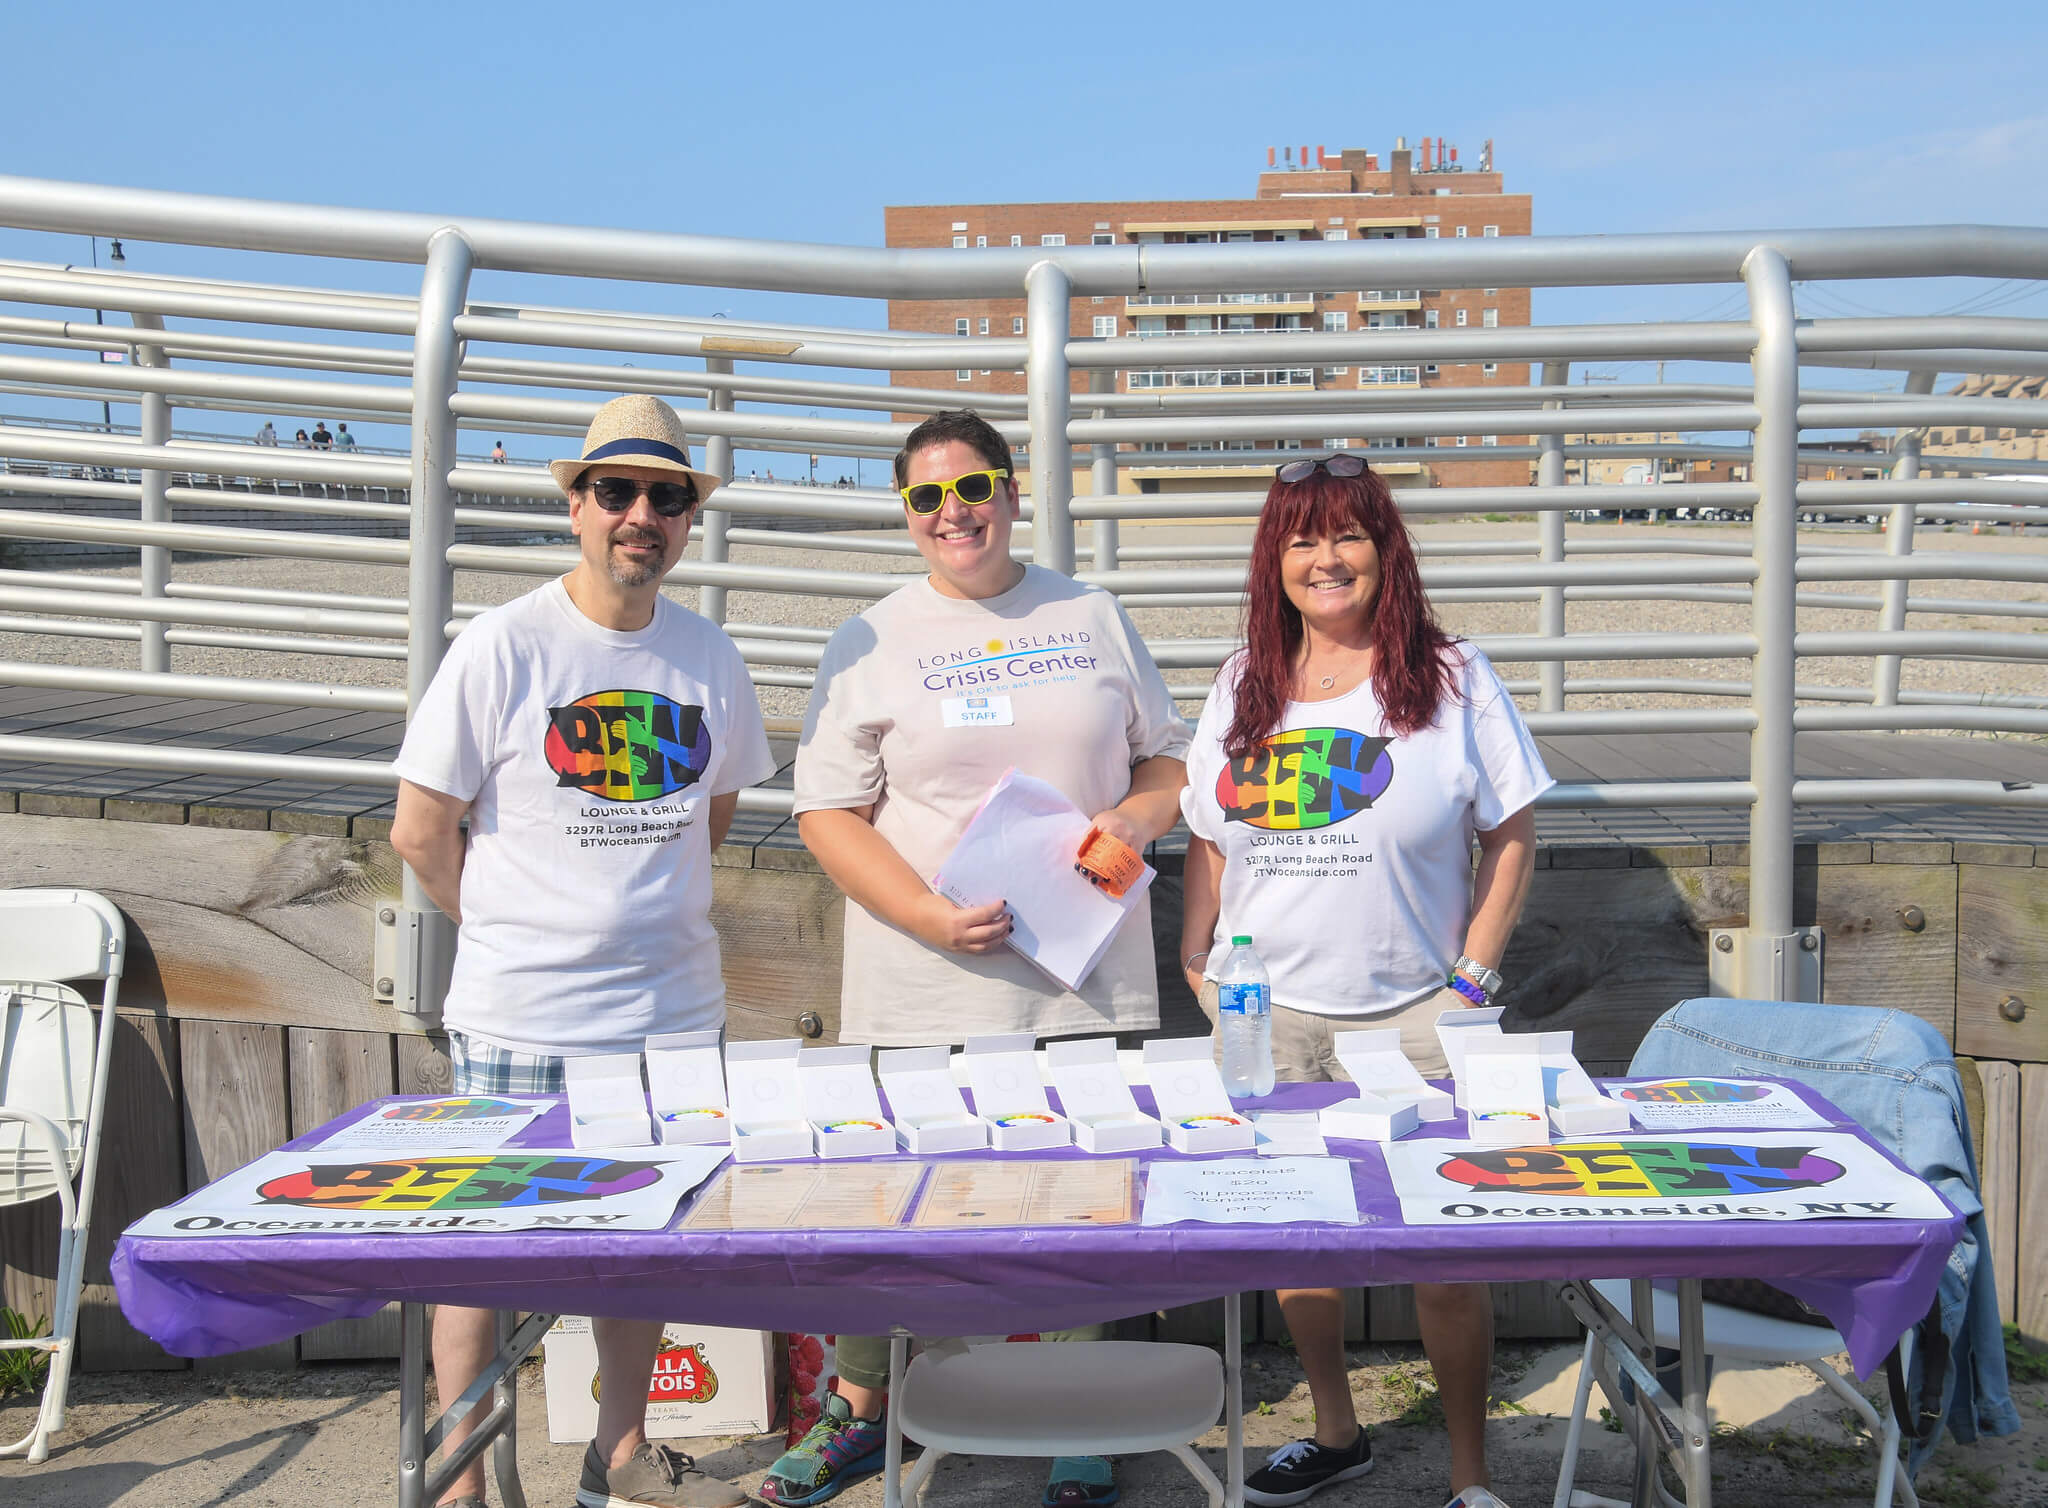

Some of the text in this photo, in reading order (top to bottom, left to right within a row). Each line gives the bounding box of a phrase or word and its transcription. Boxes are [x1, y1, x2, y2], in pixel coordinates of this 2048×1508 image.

[918, 632, 1091, 669] LONG ISLAND
[924, 653, 1096, 691] Crisis Center
[977, 687, 992, 695] OK
[1012, 681, 1029, 689] ask
[1033, 678, 1049, 686] for
[961, 711, 998, 721] STAFF
[581, 804, 689, 818] LOUNGE & GRILL
[565, 825, 604, 835] 3297R
[608, 822, 637, 834] Long
[642, 818, 674, 830] Beach
[1250, 833, 1359, 847] LOUNGE & GRILL
[1275, 855, 1302, 865] Long
[1305, 854, 1337, 864] Beach
[1343, 853, 1373, 863] Road
[1202, 1168, 1296, 1176] Bracelets
[1440, 1201, 1898, 1219] Oceanside, NY
[530, 1214, 632, 1227] NY
[652, 1357, 694, 1374] LLA
[649, 1374, 696, 1391] TOIS
